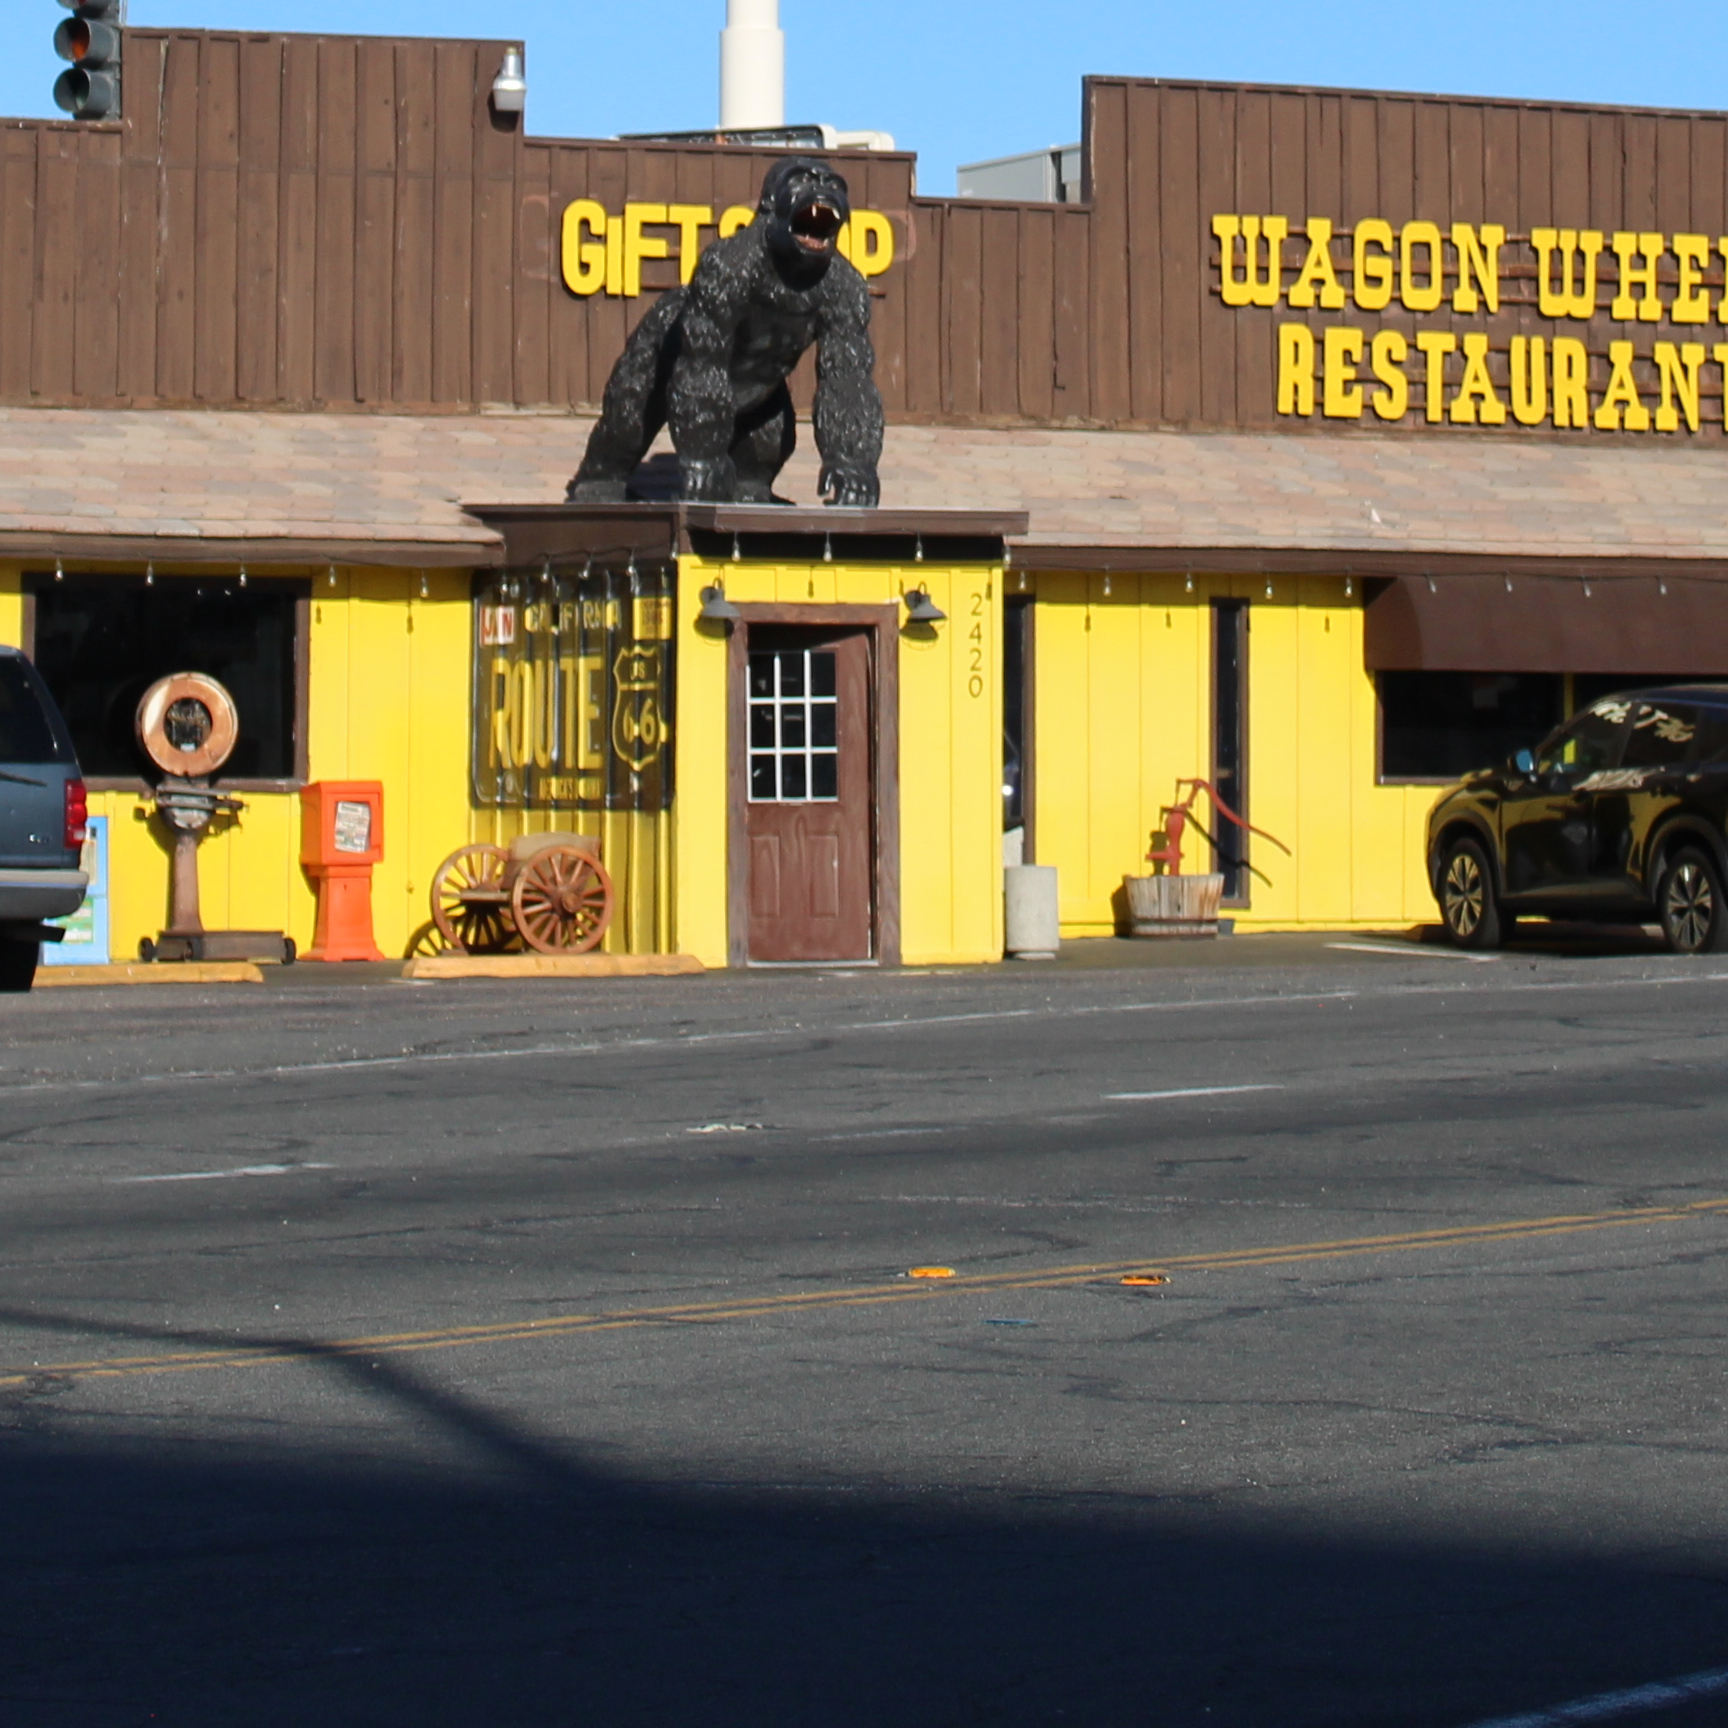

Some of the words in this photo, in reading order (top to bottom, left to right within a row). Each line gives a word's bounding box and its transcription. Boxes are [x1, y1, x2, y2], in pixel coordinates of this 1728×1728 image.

[562, 198, 713, 297] GIFT
[1211, 214, 1505, 313] WAGON
[968, 592, 983, 699] 2420
[489, 656, 603, 770] ROUTE
[623, 697, 655, 745] 66
